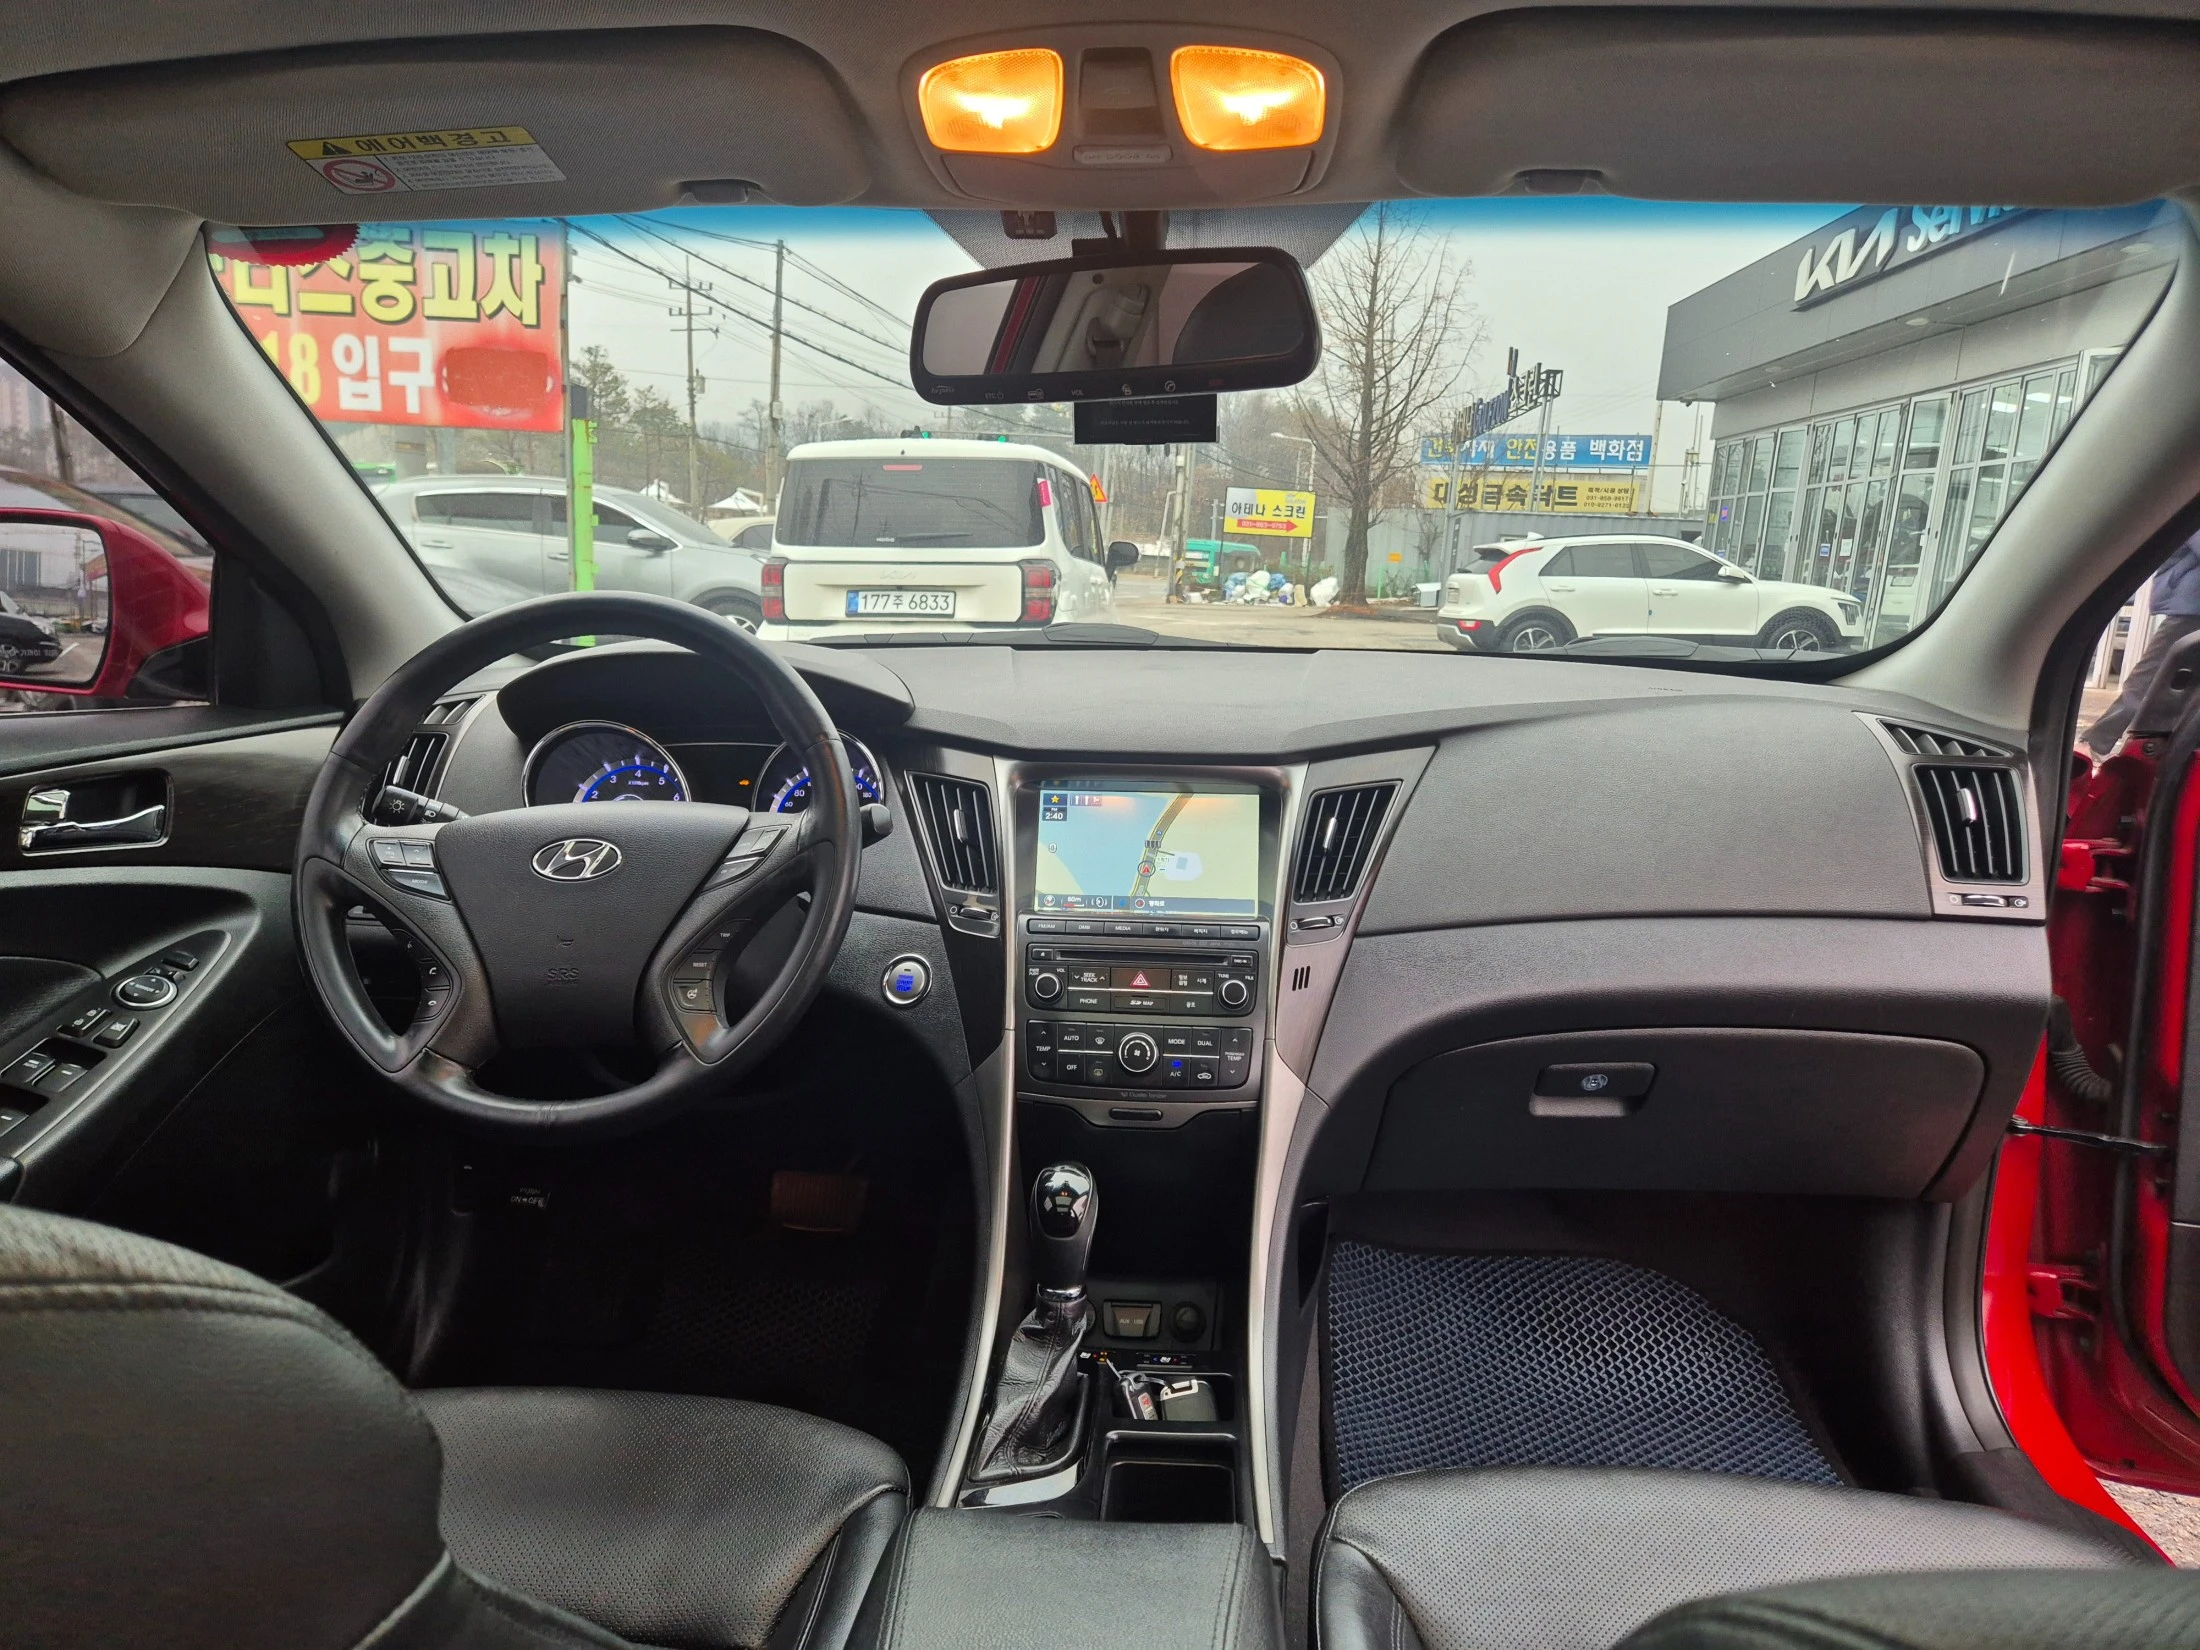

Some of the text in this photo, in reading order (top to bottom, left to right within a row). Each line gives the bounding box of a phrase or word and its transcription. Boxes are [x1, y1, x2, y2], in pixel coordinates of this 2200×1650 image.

[331, 332, 436, 414] 입구
[1589, 438, 1643, 462] 백화점
[1231, 502, 1305, 519] 아테나 스크린
[861, 594, 950, 611] 177주 6833
[634, 769, 642, 778] 4
[610, 775, 617, 784] 3
[658, 777, 665, 786] 5
[591, 790, 599, 799] 2
[673, 792, 680, 801] 6
[794, 789, 805, 797] 80
[1045, 812, 1063, 820] 2:40
[547, 967, 579, 981] SRS
